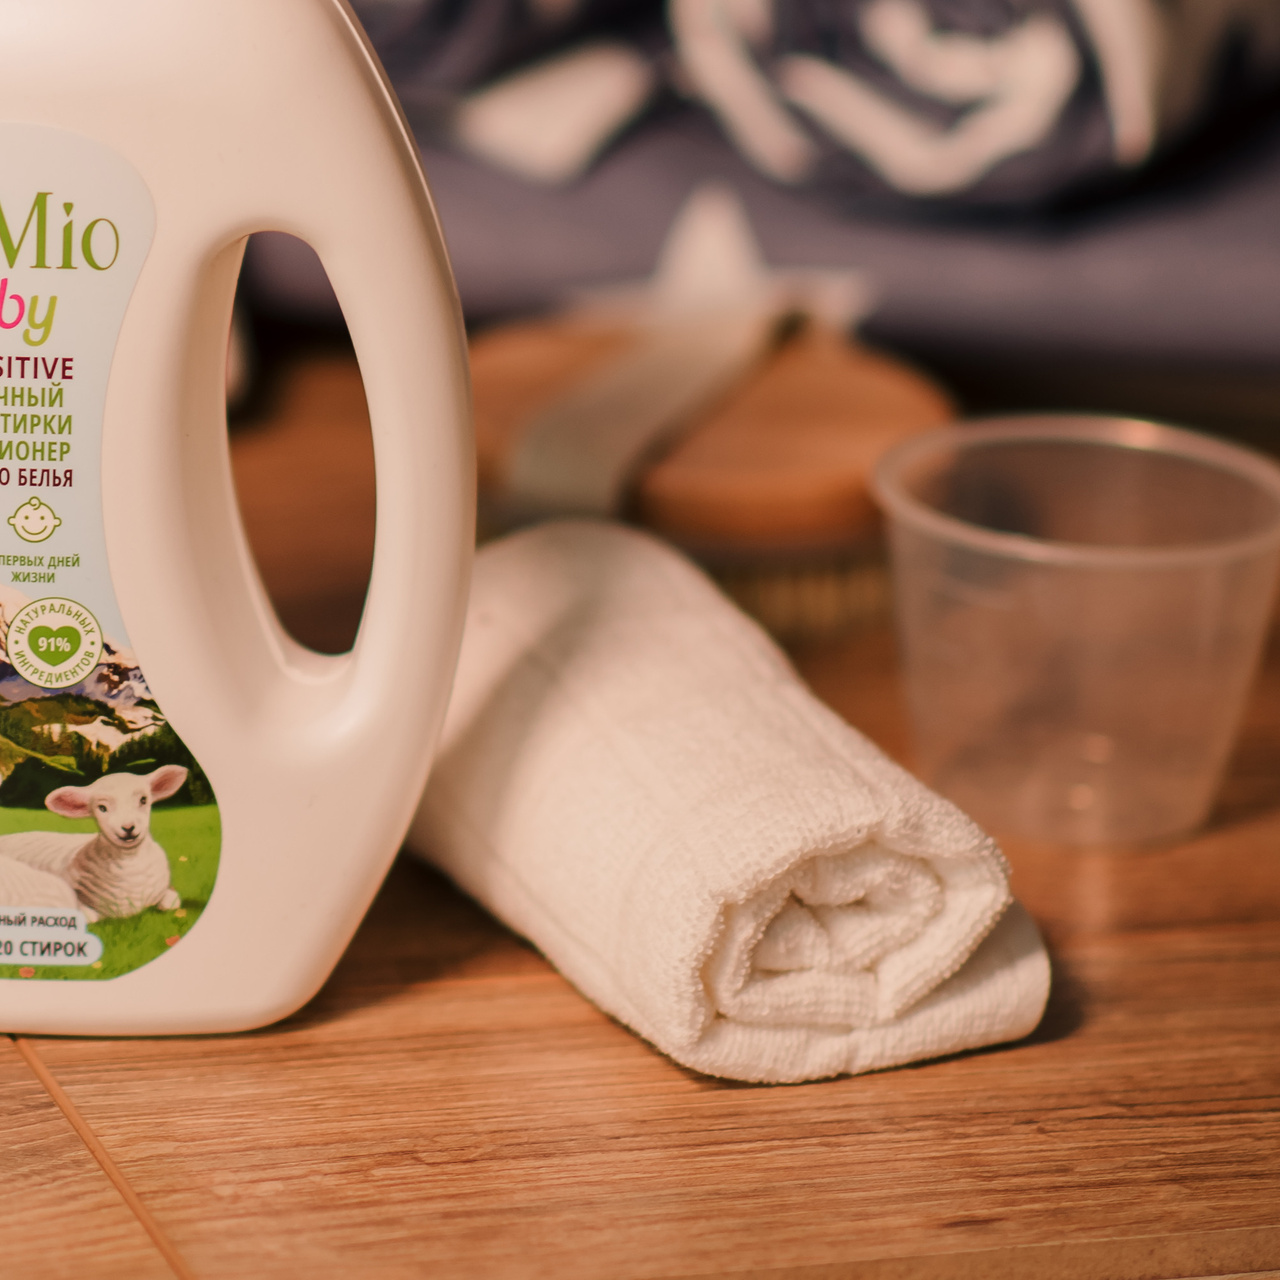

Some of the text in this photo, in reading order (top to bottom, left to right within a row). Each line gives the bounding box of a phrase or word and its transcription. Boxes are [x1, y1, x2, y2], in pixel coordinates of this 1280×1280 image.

[17, 469, 74, 488] БЕЛЬЯ
[47, 553, 81, 569] ДНЕЙ
[11, 571, 56, 584] ЖИЗНИ
[14, 603, 97, 637] НАТУРАЛЬНЫХ
[37, 635, 71, 653] 91%
[13, 649, 96, 686] ИНГРЕДИЕНТОВ
[31, 915, 78, 931] РАСХОД
[19, 940, 88, 958] СТИРОК
